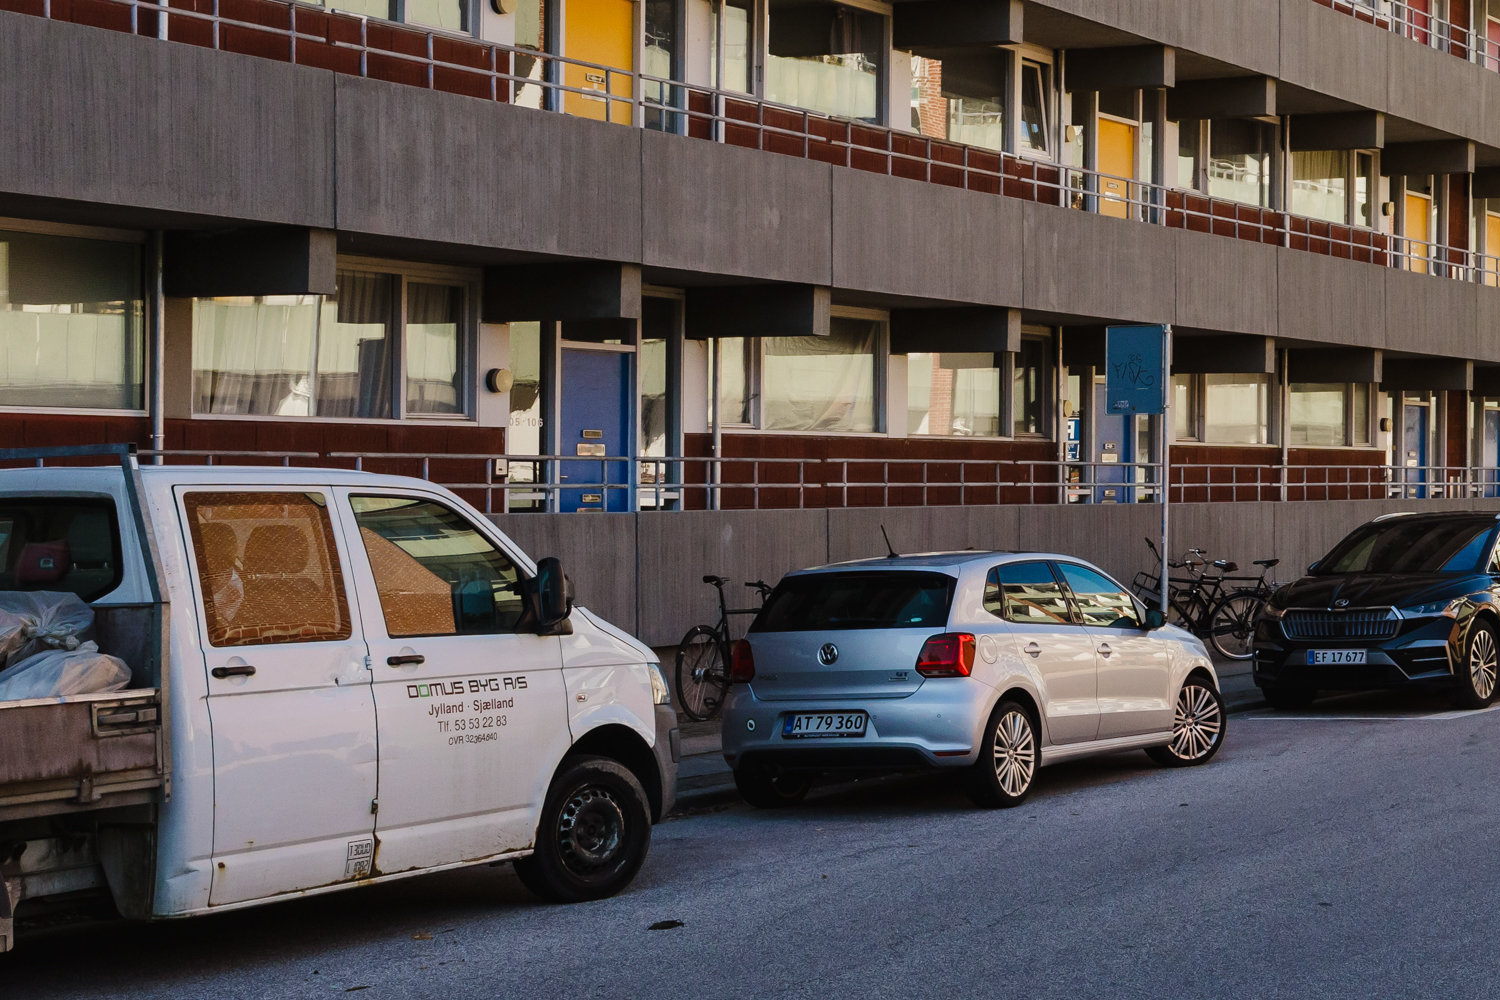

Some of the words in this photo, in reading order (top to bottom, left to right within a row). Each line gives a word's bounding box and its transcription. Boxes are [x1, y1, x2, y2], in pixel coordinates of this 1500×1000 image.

[1315, 652, 1327, 662] EF
[1331, 652, 1343, 662] 17
[1346, 652, 1364, 662] 677
[406, 681, 465, 698] DOMUS
[468, 678, 500, 693] BYG
[503, 676, 528, 690] A/S
[428, 702, 464, 718] Jylland
[473, 697, 514, 714] Sjælland
[438, 721, 452, 733] Tlf.
[455, 719, 466, 731] 53
[469, 717, 480, 730] 53
[482, 716, 493, 728] 22
[496, 715, 507, 727] 83
[793, 716, 813, 730] AT
[816, 716, 833, 730] 79
[835, 715, 863, 730] 360
[448, 735, 464, 745] CVR
